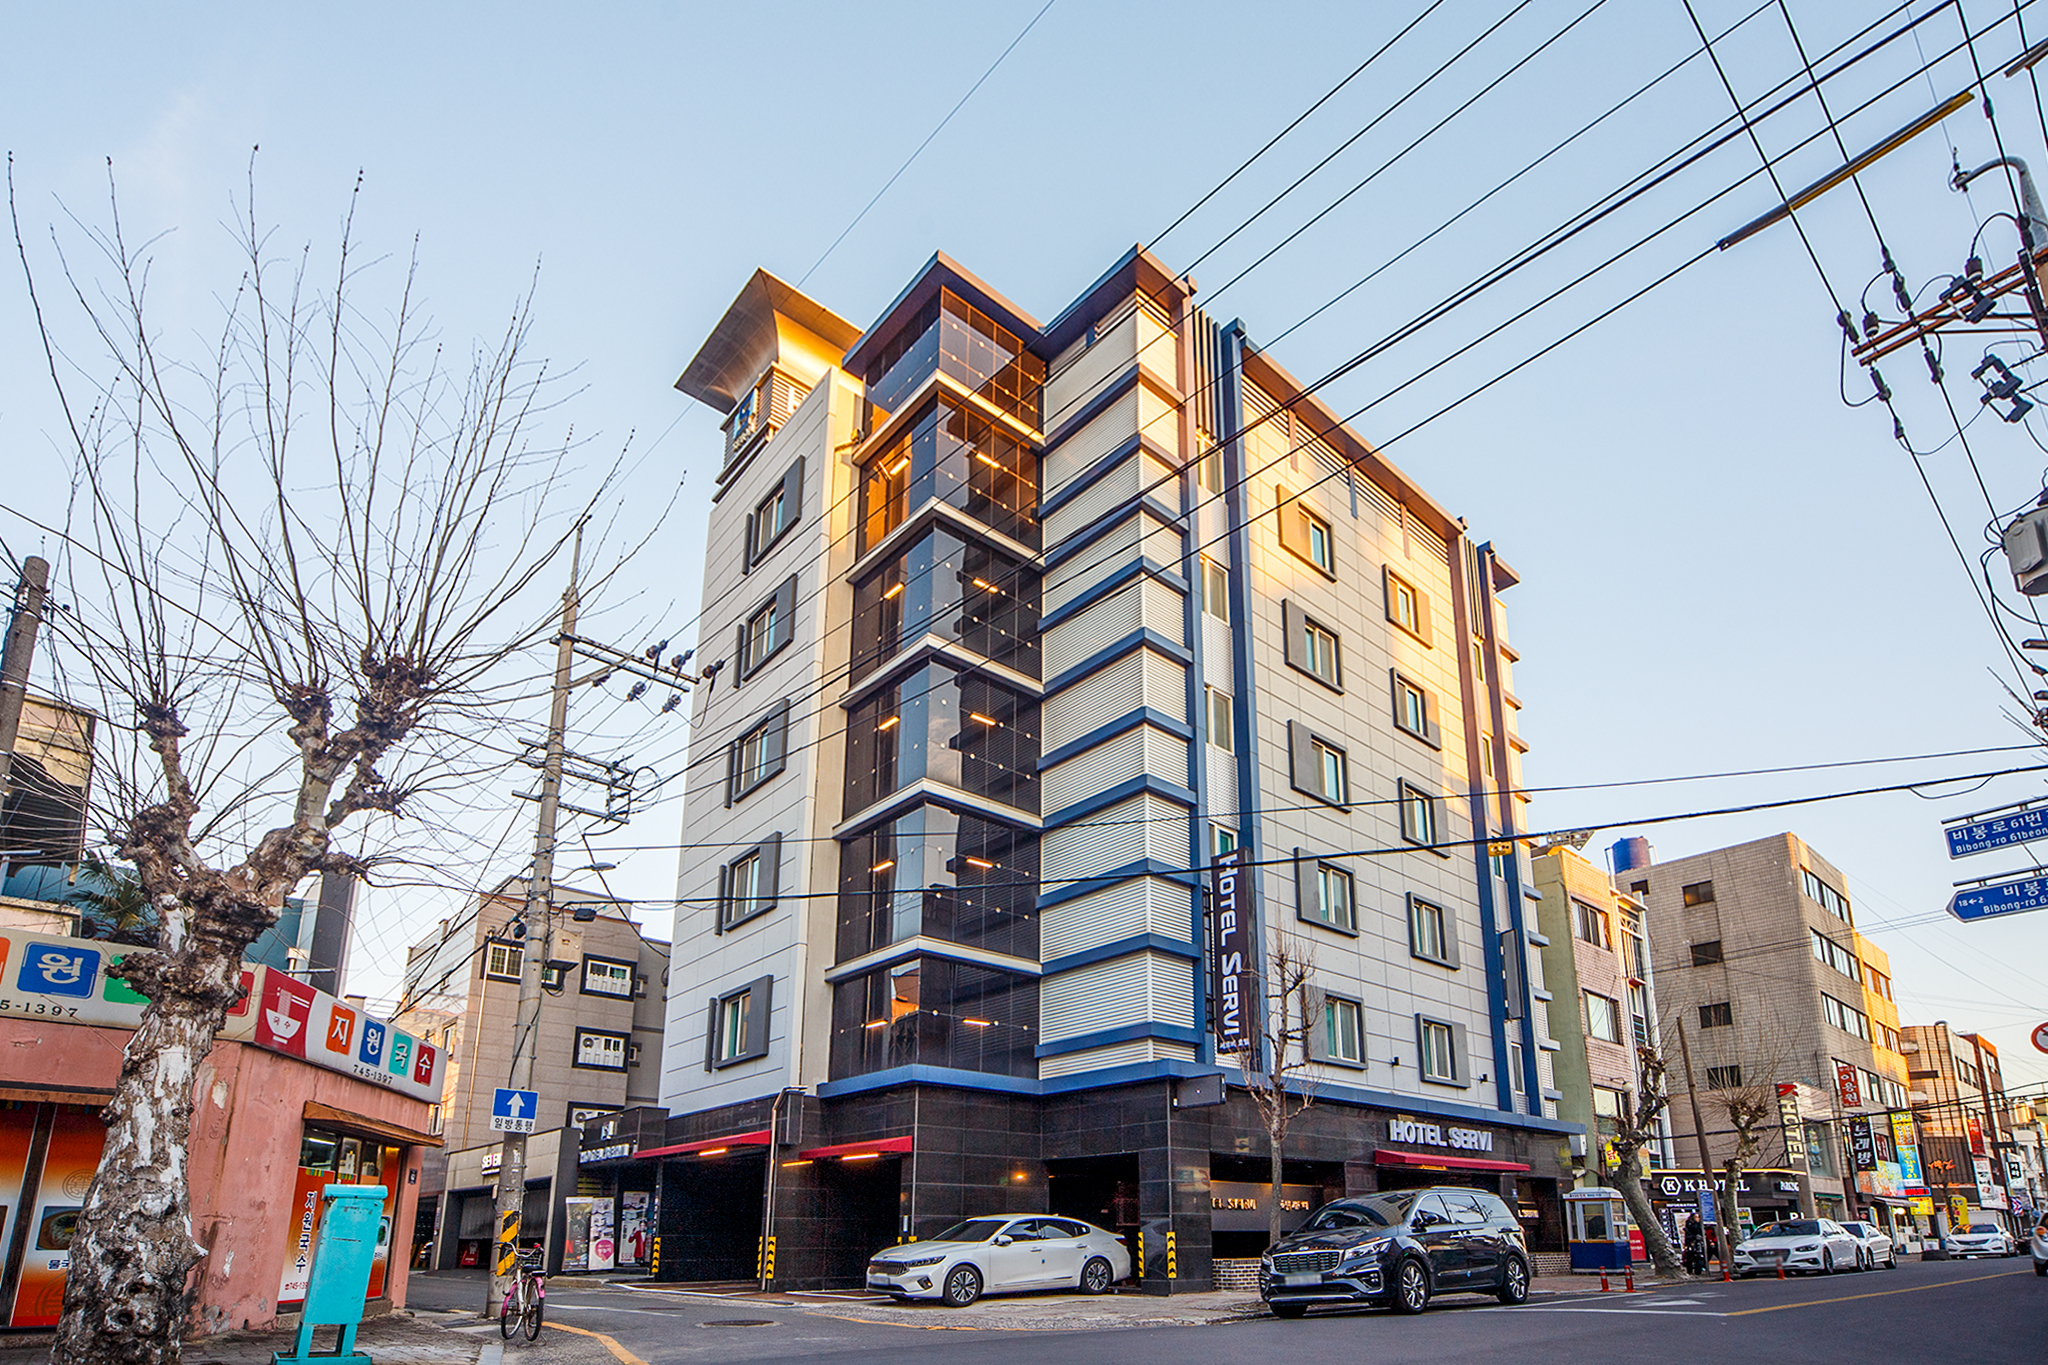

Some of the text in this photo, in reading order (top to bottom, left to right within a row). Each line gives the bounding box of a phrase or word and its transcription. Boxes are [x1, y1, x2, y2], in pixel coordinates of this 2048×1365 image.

[1952, 810, 2048, 841] 비봉로61번
[1955, 837, 2007, 854] Bibong-ro
[1219, 853, 1239, 947] HOTEL
[2003, 880, 2048, 897] 비봉
[1983, 899, 2036, 914] Bibong-ro
[1221, 951, 1242, 1037] SERVI
[331, 1014, 432, 1077] 지원국수
[353, 1064, 393, 1085] 745-1397
[495, 1117, 533, 1132] 일방통행
[1389, 1119, 1493, 1152] HOTEL SERVI
[1780, 1099, 1804, 1164] HOTEL
[1852, 1125, 1873, 1165] 노래방
[1684, 1180, 1697, 1192] K
[295, 1191, 318, 1274] 지원국수
